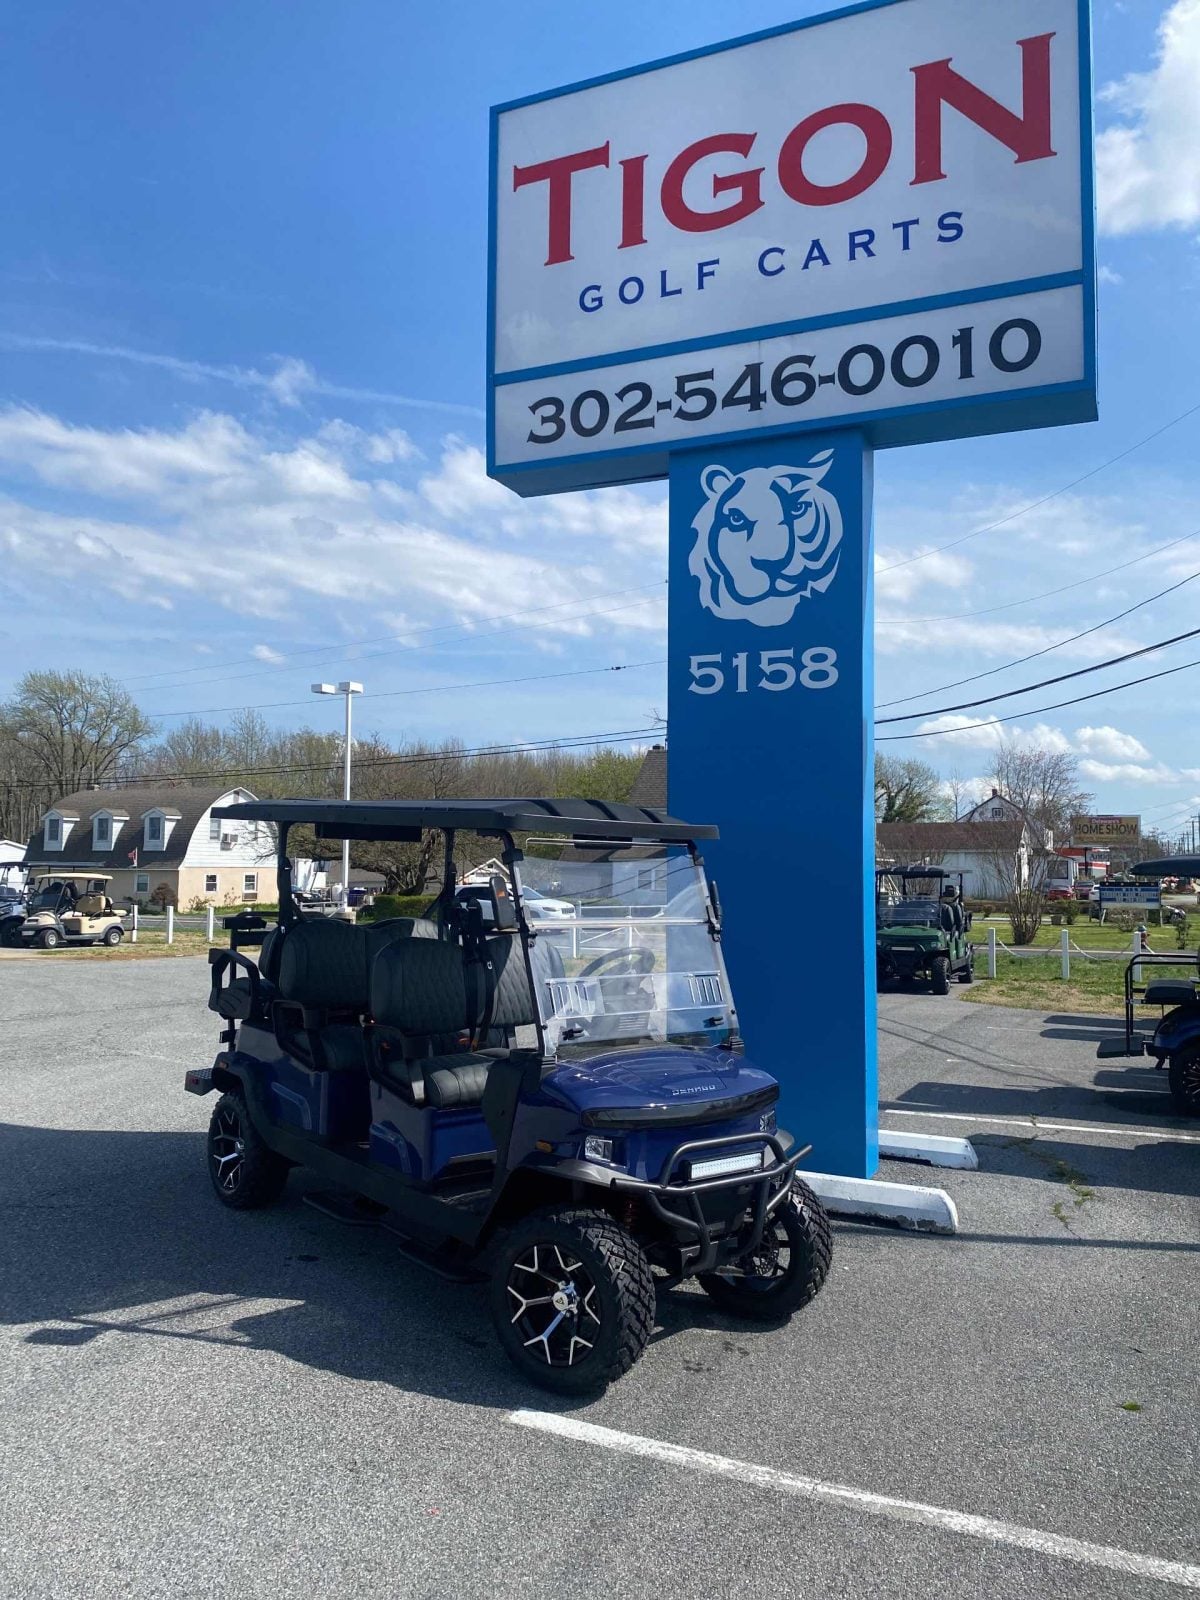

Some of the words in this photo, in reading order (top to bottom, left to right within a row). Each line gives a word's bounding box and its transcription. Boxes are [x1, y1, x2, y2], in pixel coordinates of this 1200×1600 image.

[513, 32, 1057, 266] TIGON
[578, 258, 720, 313] GOLF
[757, 211, 964, 278] CARTS
[526, 317, 1042, 445] 302-546-0010
[687, 646, 839, 695] 5158
